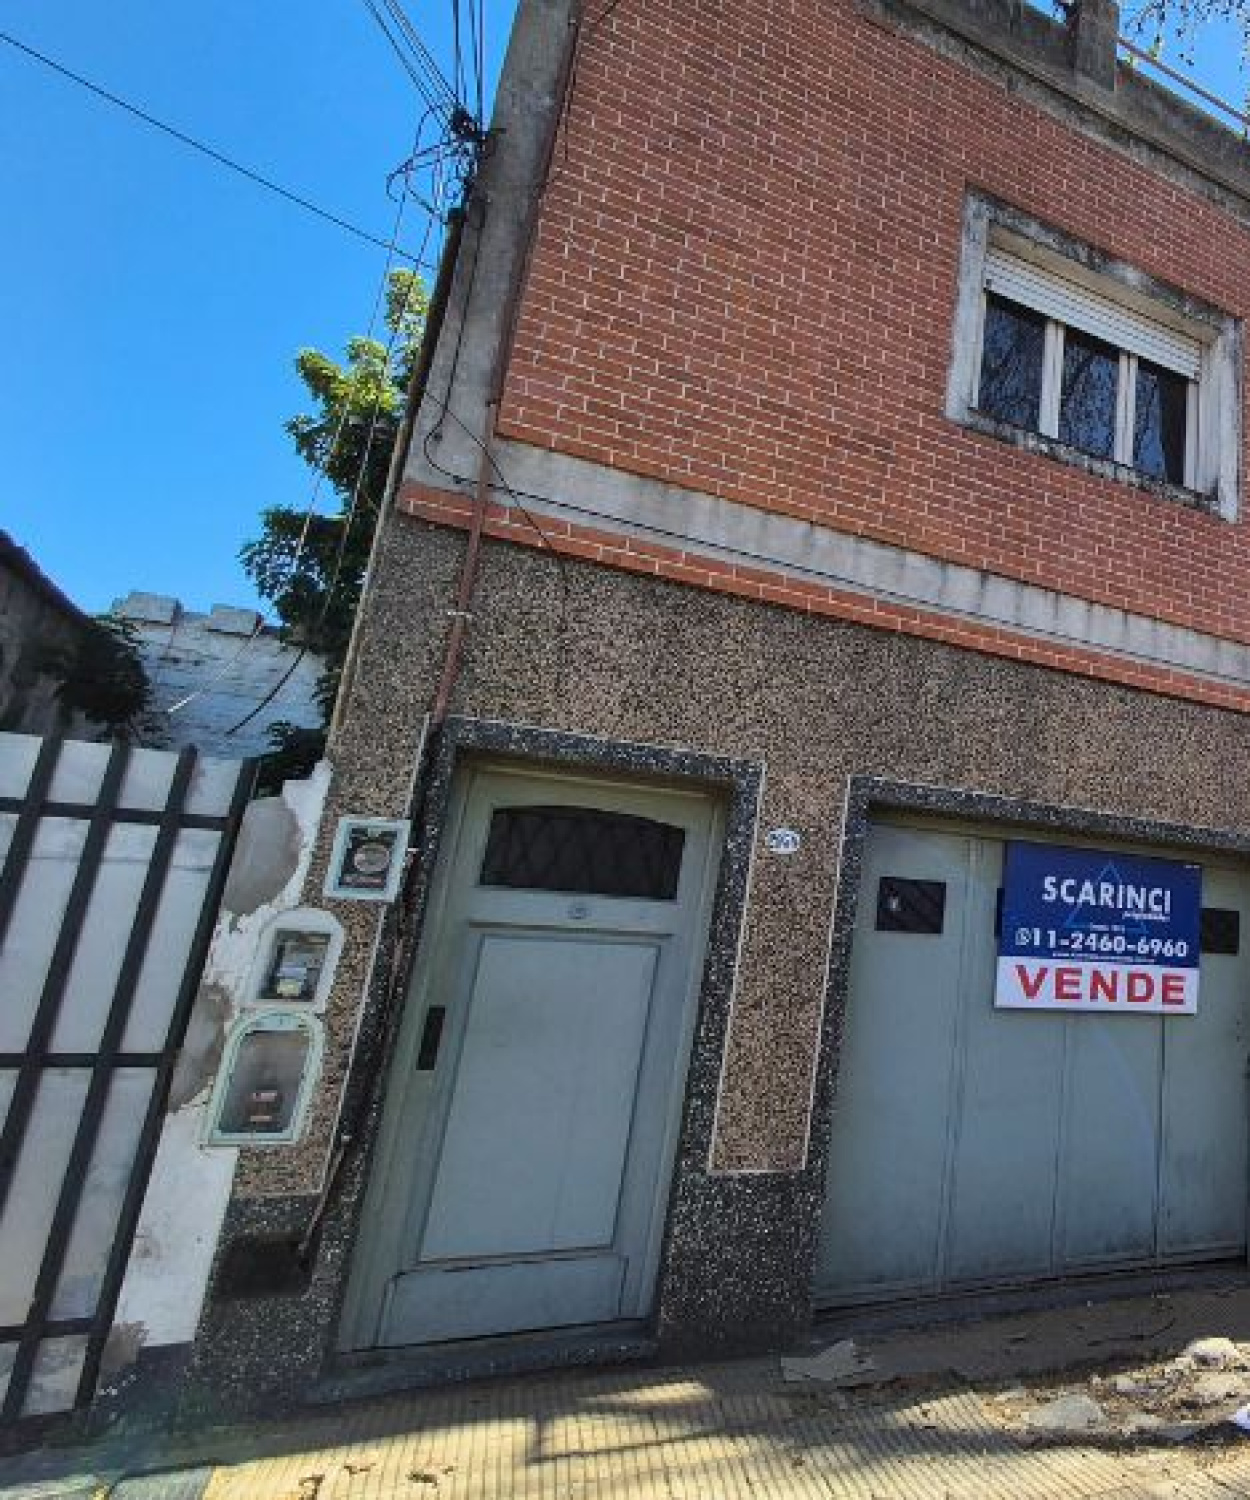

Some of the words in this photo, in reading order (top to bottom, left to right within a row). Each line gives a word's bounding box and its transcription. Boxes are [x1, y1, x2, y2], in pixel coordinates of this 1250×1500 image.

[1042, 876, 1171, 914] SCARINCI
[1033, 927, 1188, 957] 11-2460-6960
[1015, 964, 1187, 1005] VENDE
